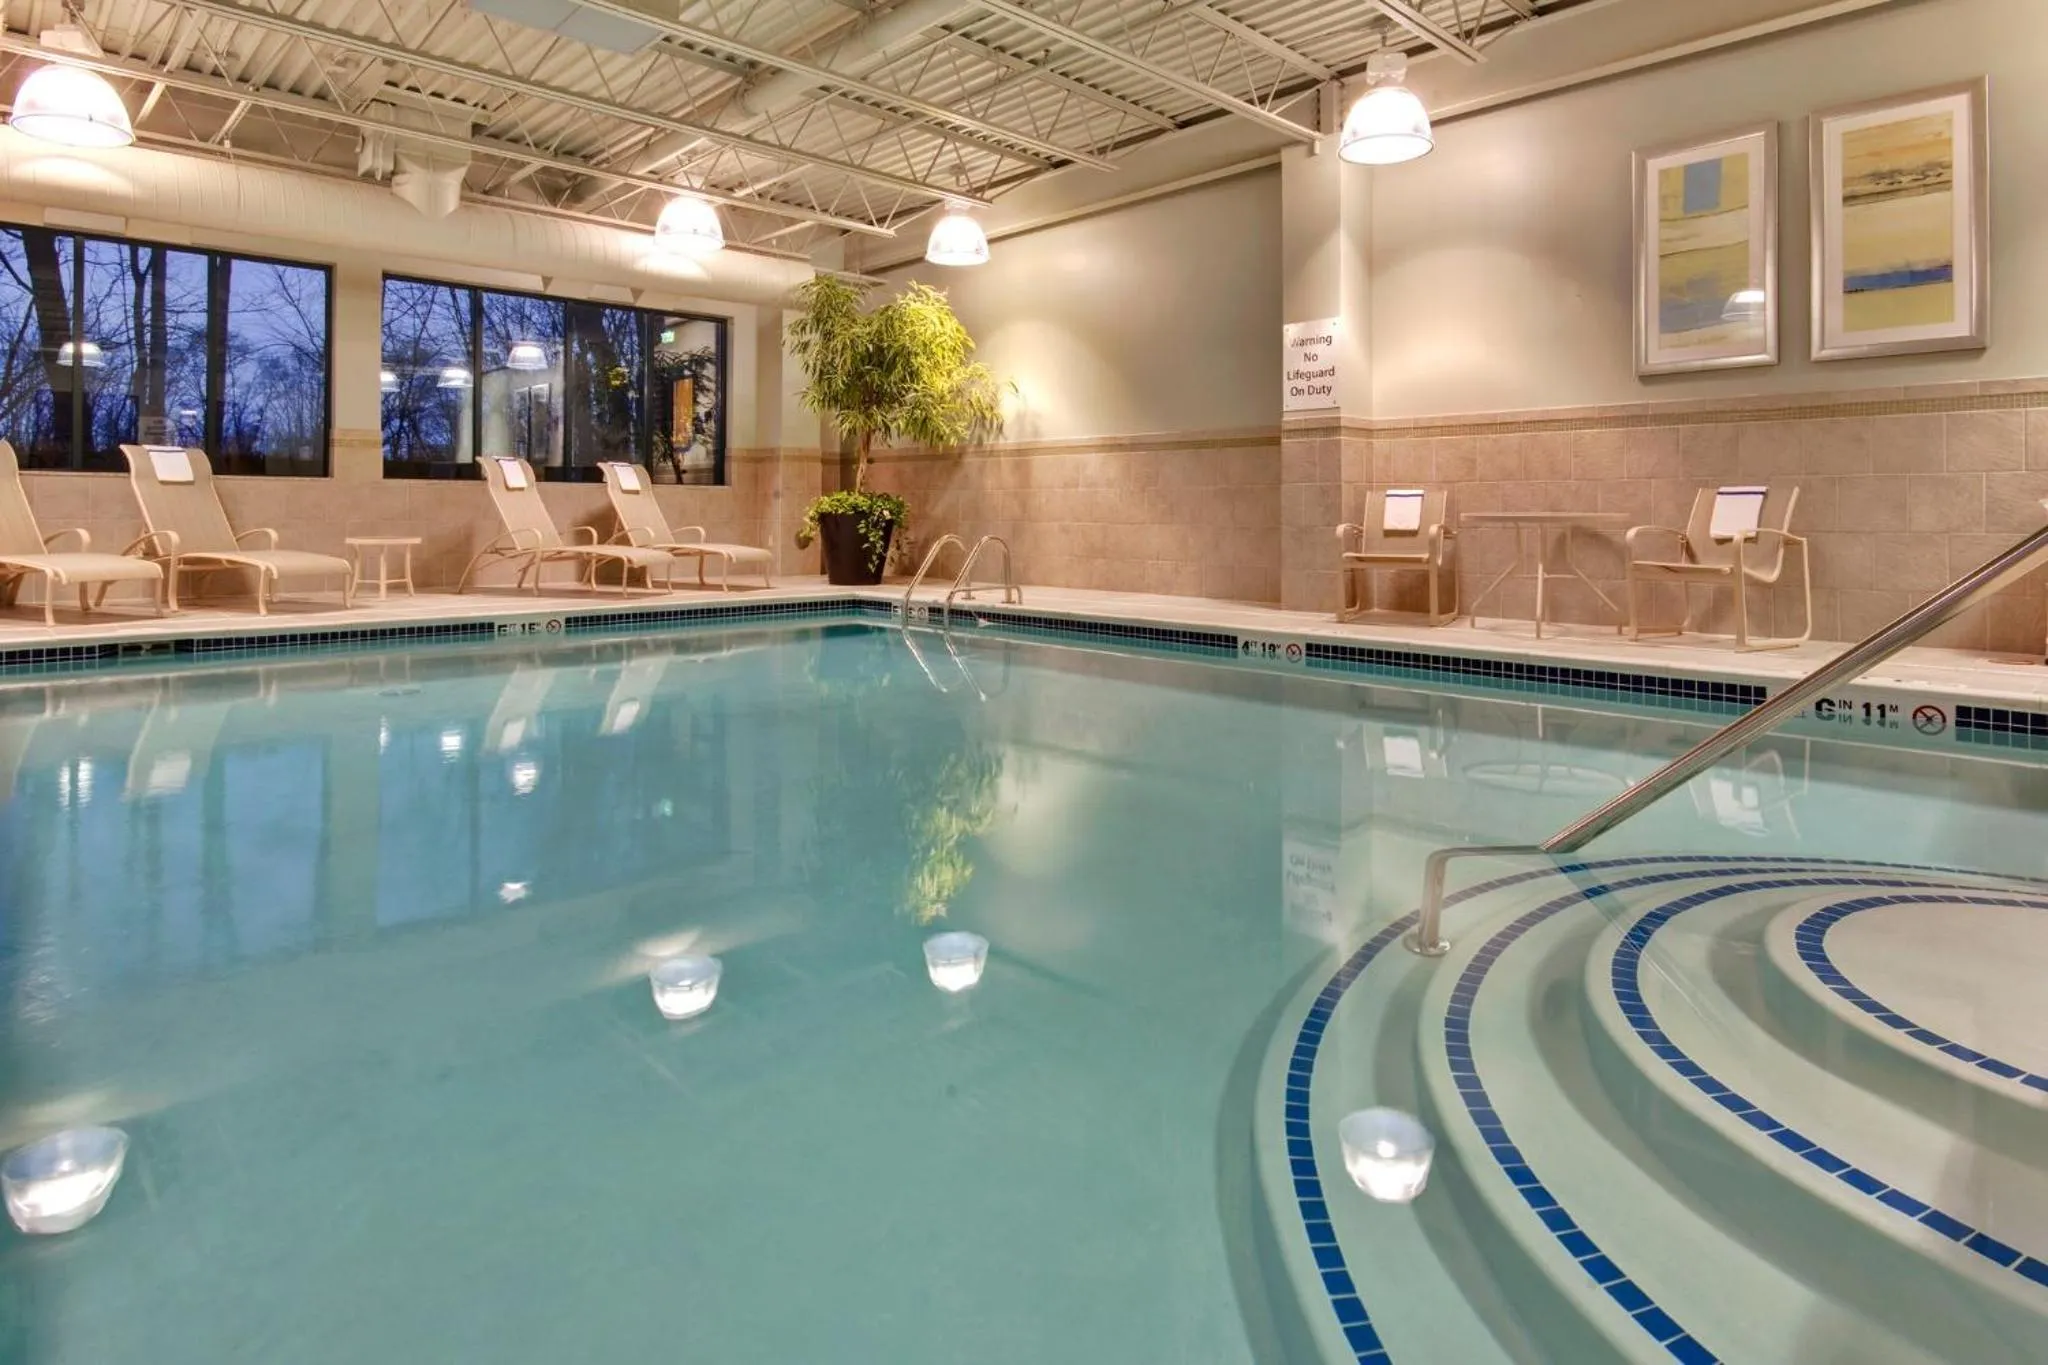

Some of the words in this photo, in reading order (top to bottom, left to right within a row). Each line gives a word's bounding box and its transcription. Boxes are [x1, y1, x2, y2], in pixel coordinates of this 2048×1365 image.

[1303, 352, 1319, 362] No
[1286, 366, 1336, 382] Lifeguard
[1290, 386, 1305, 397] On
[1307, 384, 1333, 397] Duty
